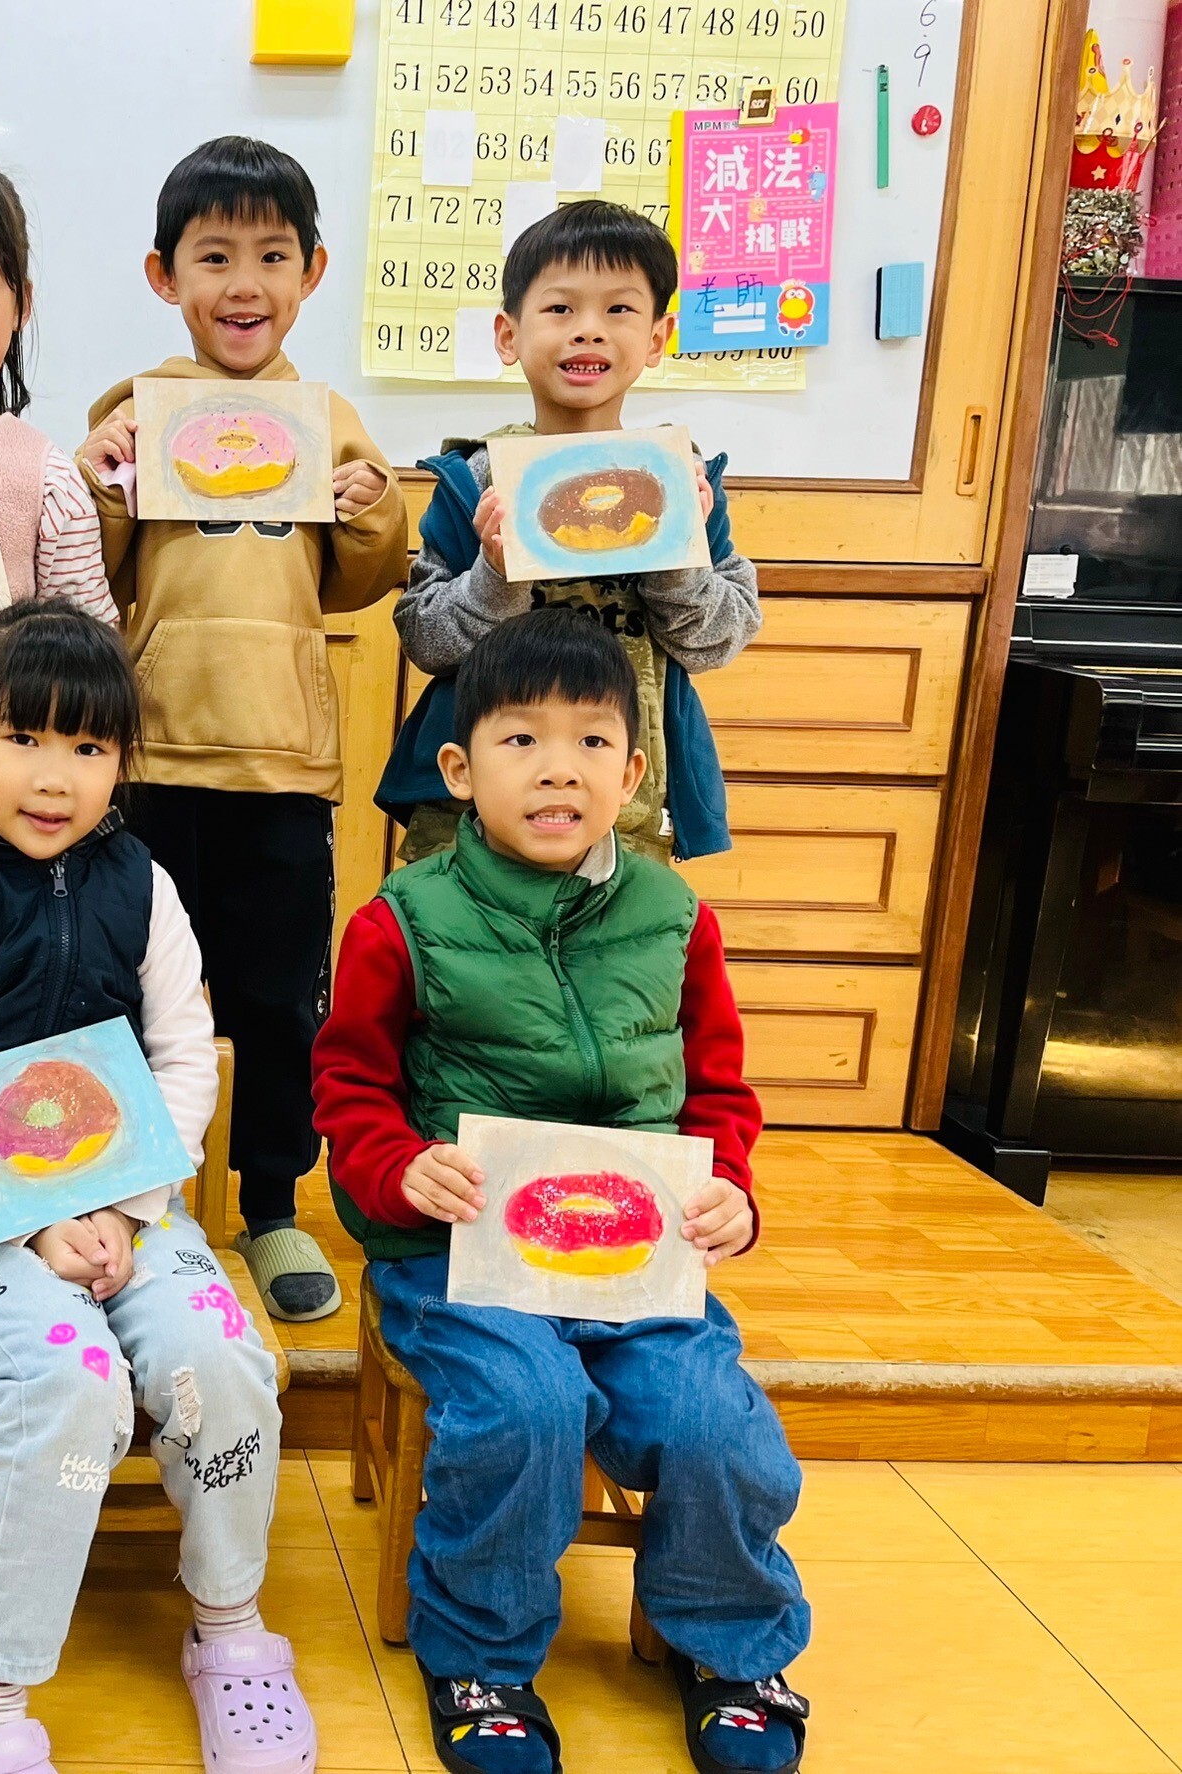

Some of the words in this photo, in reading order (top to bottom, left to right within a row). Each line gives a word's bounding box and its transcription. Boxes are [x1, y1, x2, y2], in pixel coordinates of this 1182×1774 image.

[396, 0, 425, 24] 41
[439, 0, 472, 26] 42
[483, 0, 516, 28] 43
[527, 2, 559, 30] 44
[569, 3, 602, 32] 45
[613, 5, 646, 34] 46
[657, 6, 692, 35] 47
[702, 7, 735, 36] 48
[746, 8, 780, 37] 49
[792, 10, 825, 39] 50
[393, 63, 422, 91] 51
[436, 65, 469, 93] 52
[479, 66, 511, 95] 53
[523, 68, 555, 97] 54
[566, 70, 597, 98] 55
[609, 72, 641, 100] 56
[652, 73, 686, 101] 57
[696, 74, 728, 102] 58
[785, 76, 818, 105] 60
[914, 44, 931, 87] 9
[390, 129, 418, 157] 61
[476, 132, 508, 161] 63
[519, 134, 550, 162] 64
[604, 137, 636, 166] 66
[703, 144, 802, 192] 減法
[386, 195, 414, 223] 71
[430, 196, 460, 224] 72
[473, 198, 503, 226] 73
[642, 204, 671, 231] 77
[381, 260, 408, 287] 81
[424, 261, 455, 289] 82
[466, 263, 498, 291] 83
[694, 273, 764, 319] 老師
[377, 324, 404, 351] 91
[420, 326, 450, 353] 92
